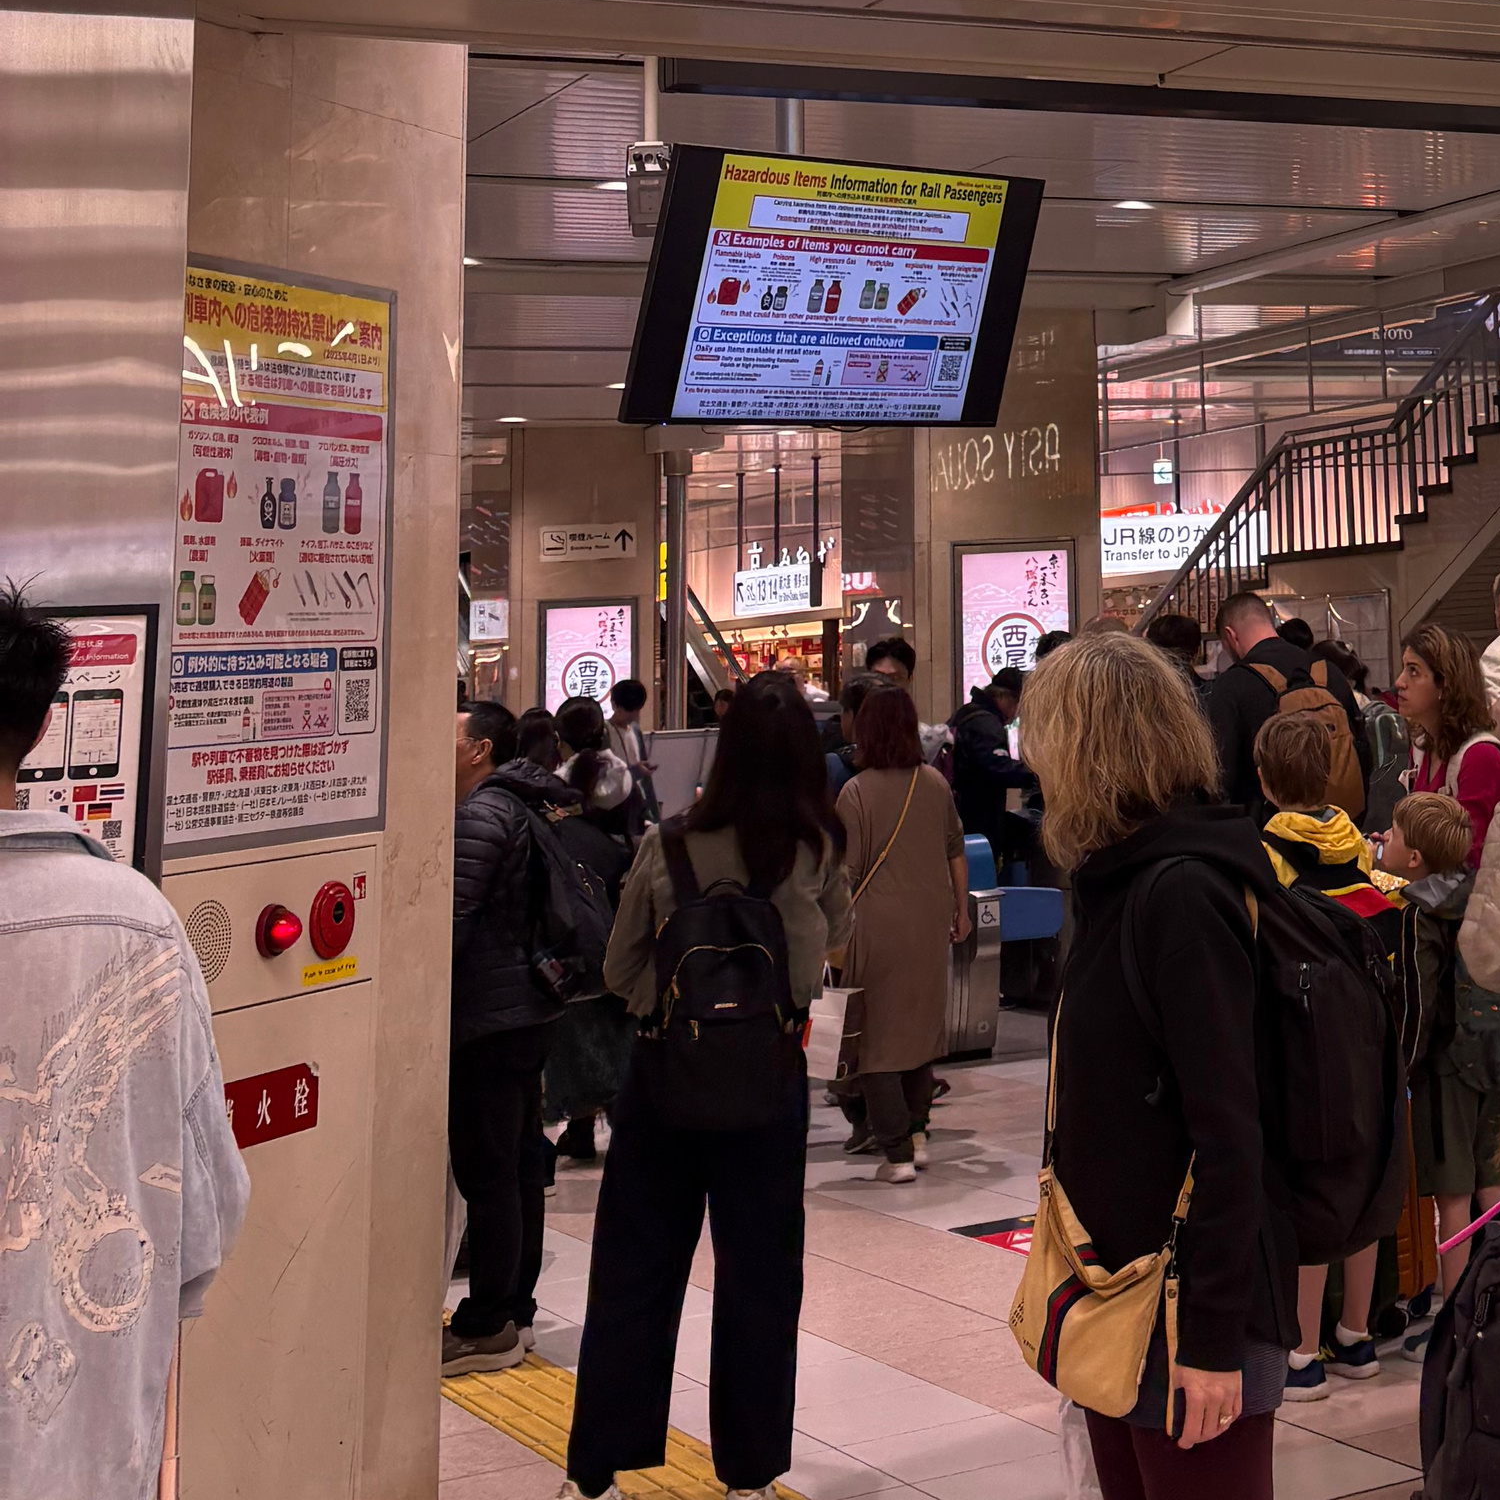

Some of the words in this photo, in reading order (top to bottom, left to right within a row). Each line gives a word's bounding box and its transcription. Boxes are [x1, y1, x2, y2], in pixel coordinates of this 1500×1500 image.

[724, 163, 790, 188] Hazardous
[793, 170, 827, 190] Items
[830, 173, 897, 196] Information
[901, 179, 916, 197] for
[920, 182, 941, 200] Rail
[943, 184, 1003, 206] Passengers
[733, 234, 786, 252] Examples
[787, 238, 800, 250] of
[801, 240, 830, 252] Items
[832, 243, 852, 256] you
[853, 244, 888, 257] cannot
[890, 247, 917, 259] carry
[187, 274, 289, 303] なさまの安全・安心のために
[713, 330, 773, 345] Exceptions
[775, 332, 797, 345] that
[800, 335, 818, 345] are
[820, 334, 861, 347] allowed
[862, 335, 906, 348] onboard
[1104, 550, 1154, 562] Transfer
[1158, 548, 1170, 560] to
[1173, 546, 1190, 559] JR
[757, 580, 767, 602] 13
[1002, 624, 1028, 672] 西尾
[188, 653, 329, 674] 例外的に持ち込み可能となる場合
[578, 660, 599, 698] 西尾
